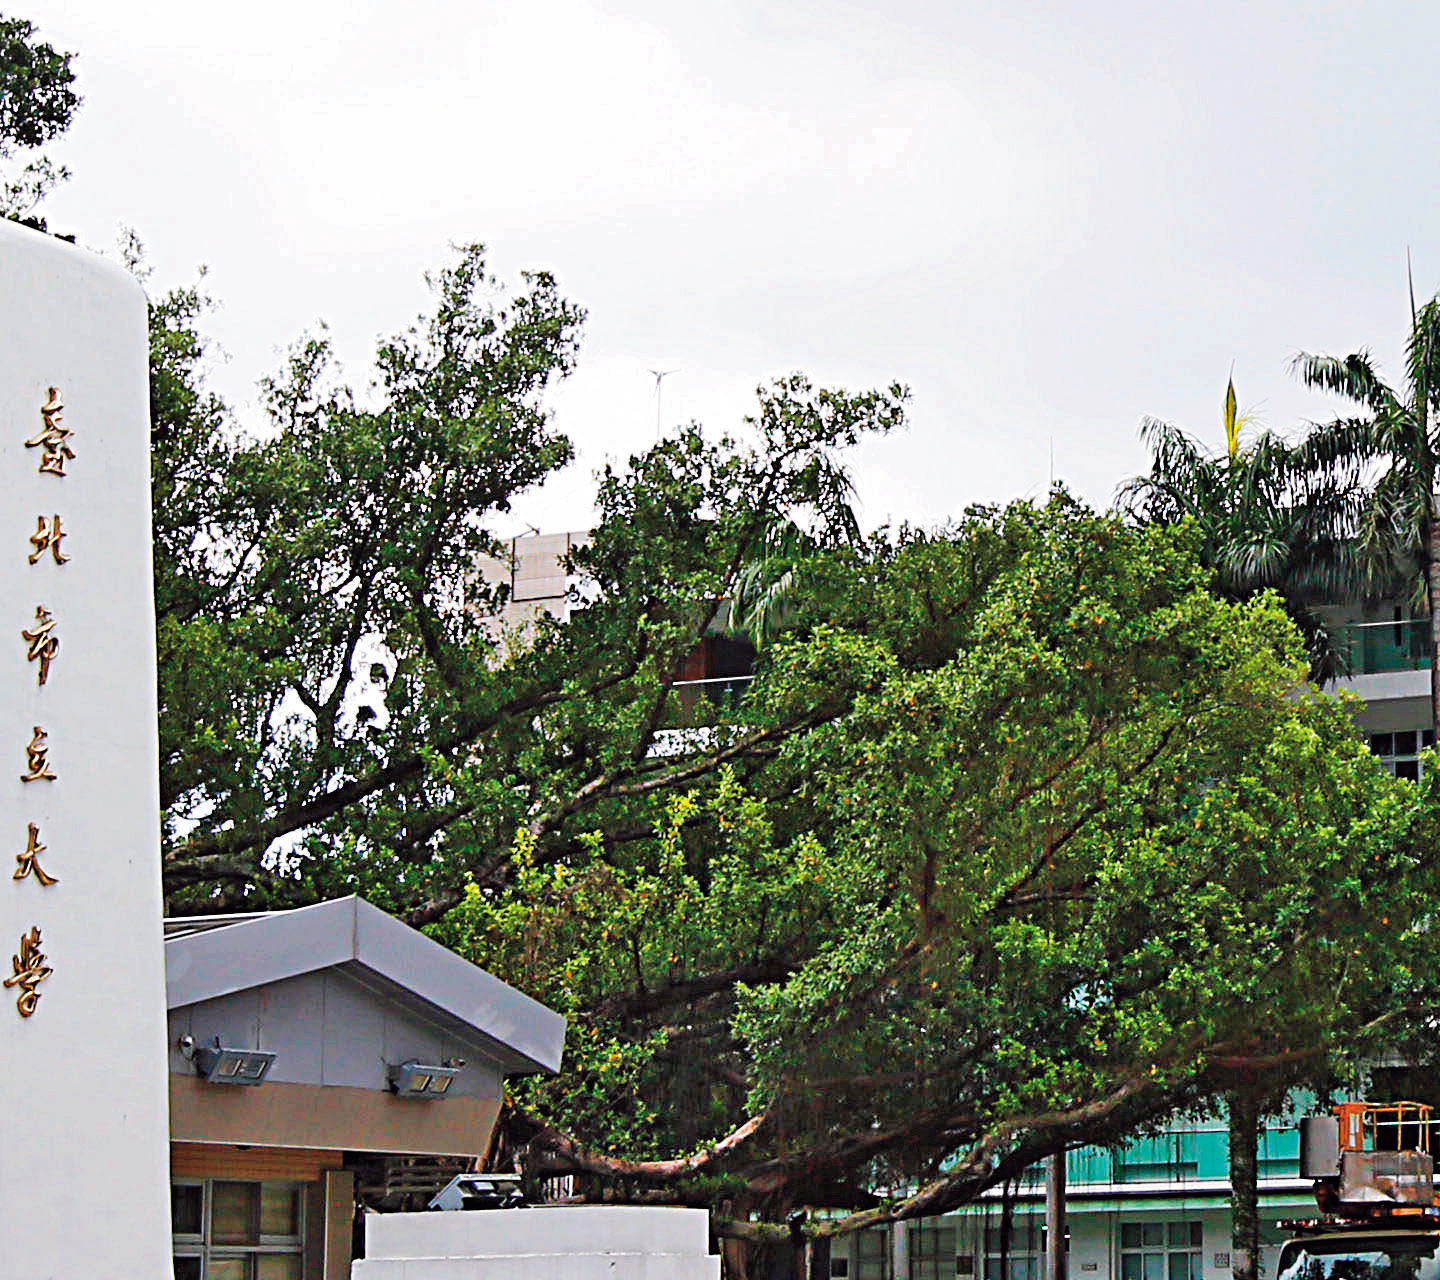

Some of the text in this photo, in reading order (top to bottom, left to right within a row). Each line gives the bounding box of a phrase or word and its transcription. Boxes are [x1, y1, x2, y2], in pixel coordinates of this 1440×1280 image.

[3, 385, 78, 1018] 臺北市立大學
